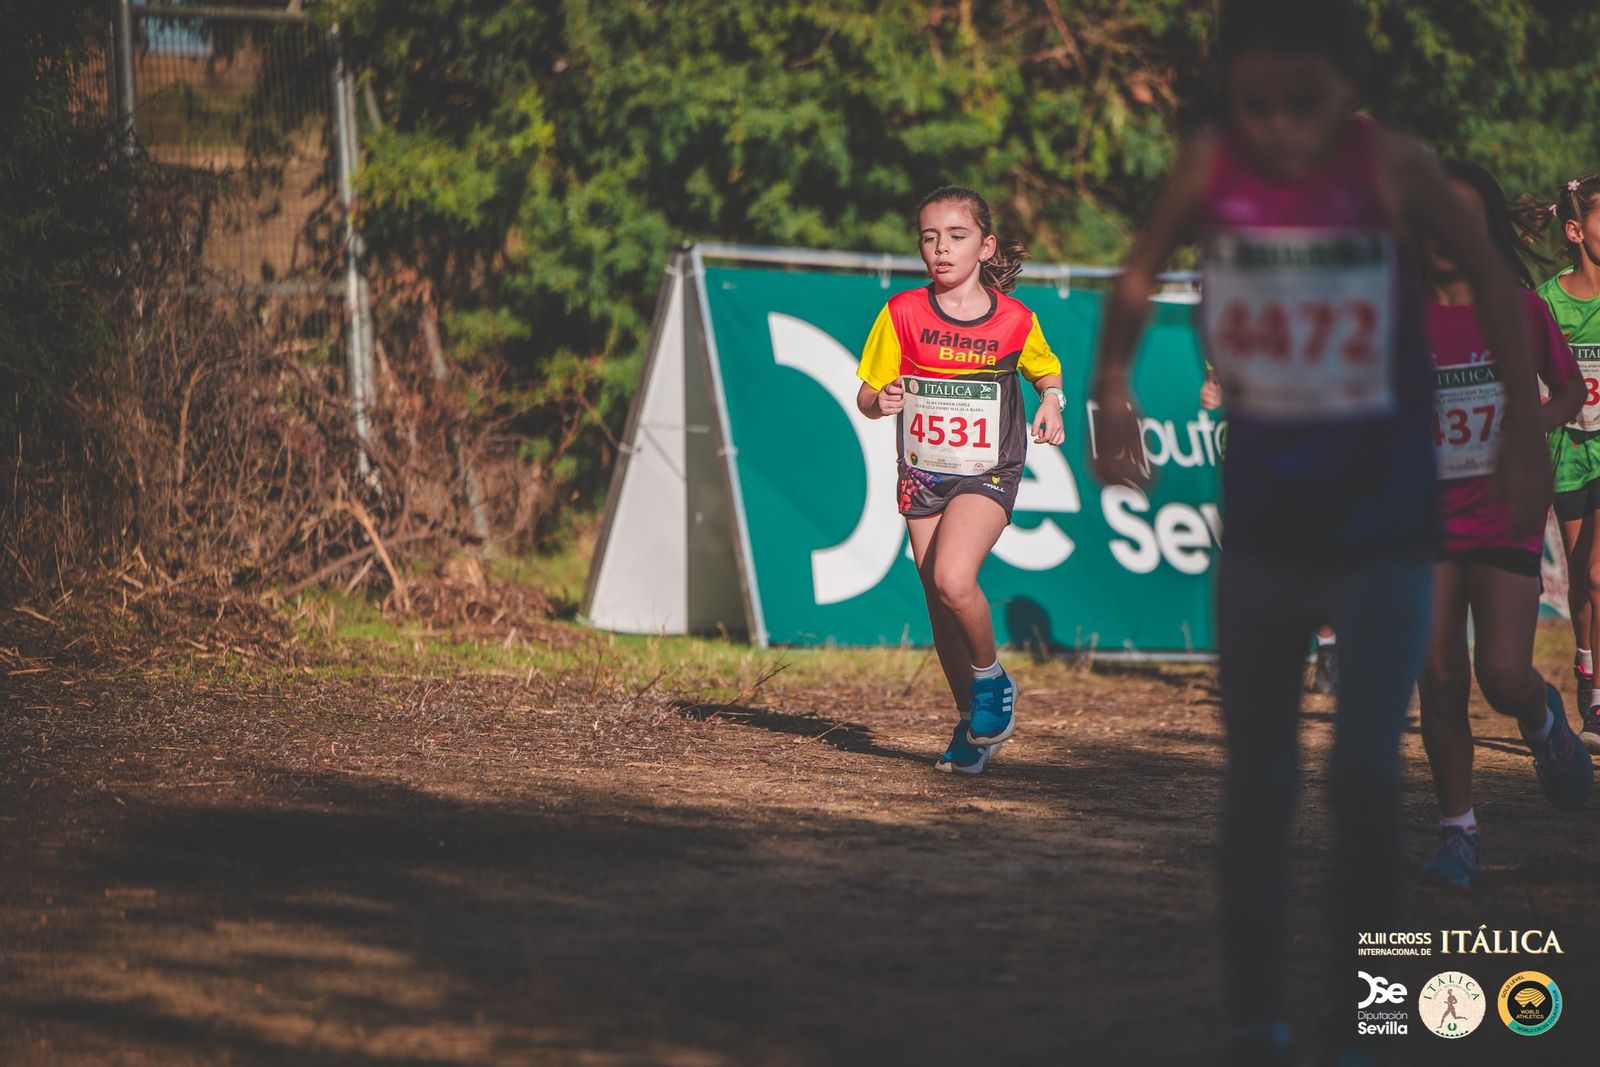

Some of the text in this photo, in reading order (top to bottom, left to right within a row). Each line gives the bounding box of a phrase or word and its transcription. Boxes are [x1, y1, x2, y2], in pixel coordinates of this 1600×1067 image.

[920, 328, 998, 355] Málaga
[1218, 297, 1379, 369] 4472
[939, 346, 996, 366] Bahía
[924, 383, 972, 396] ITÁLICA
[909, 412, 991, 448] 4531
